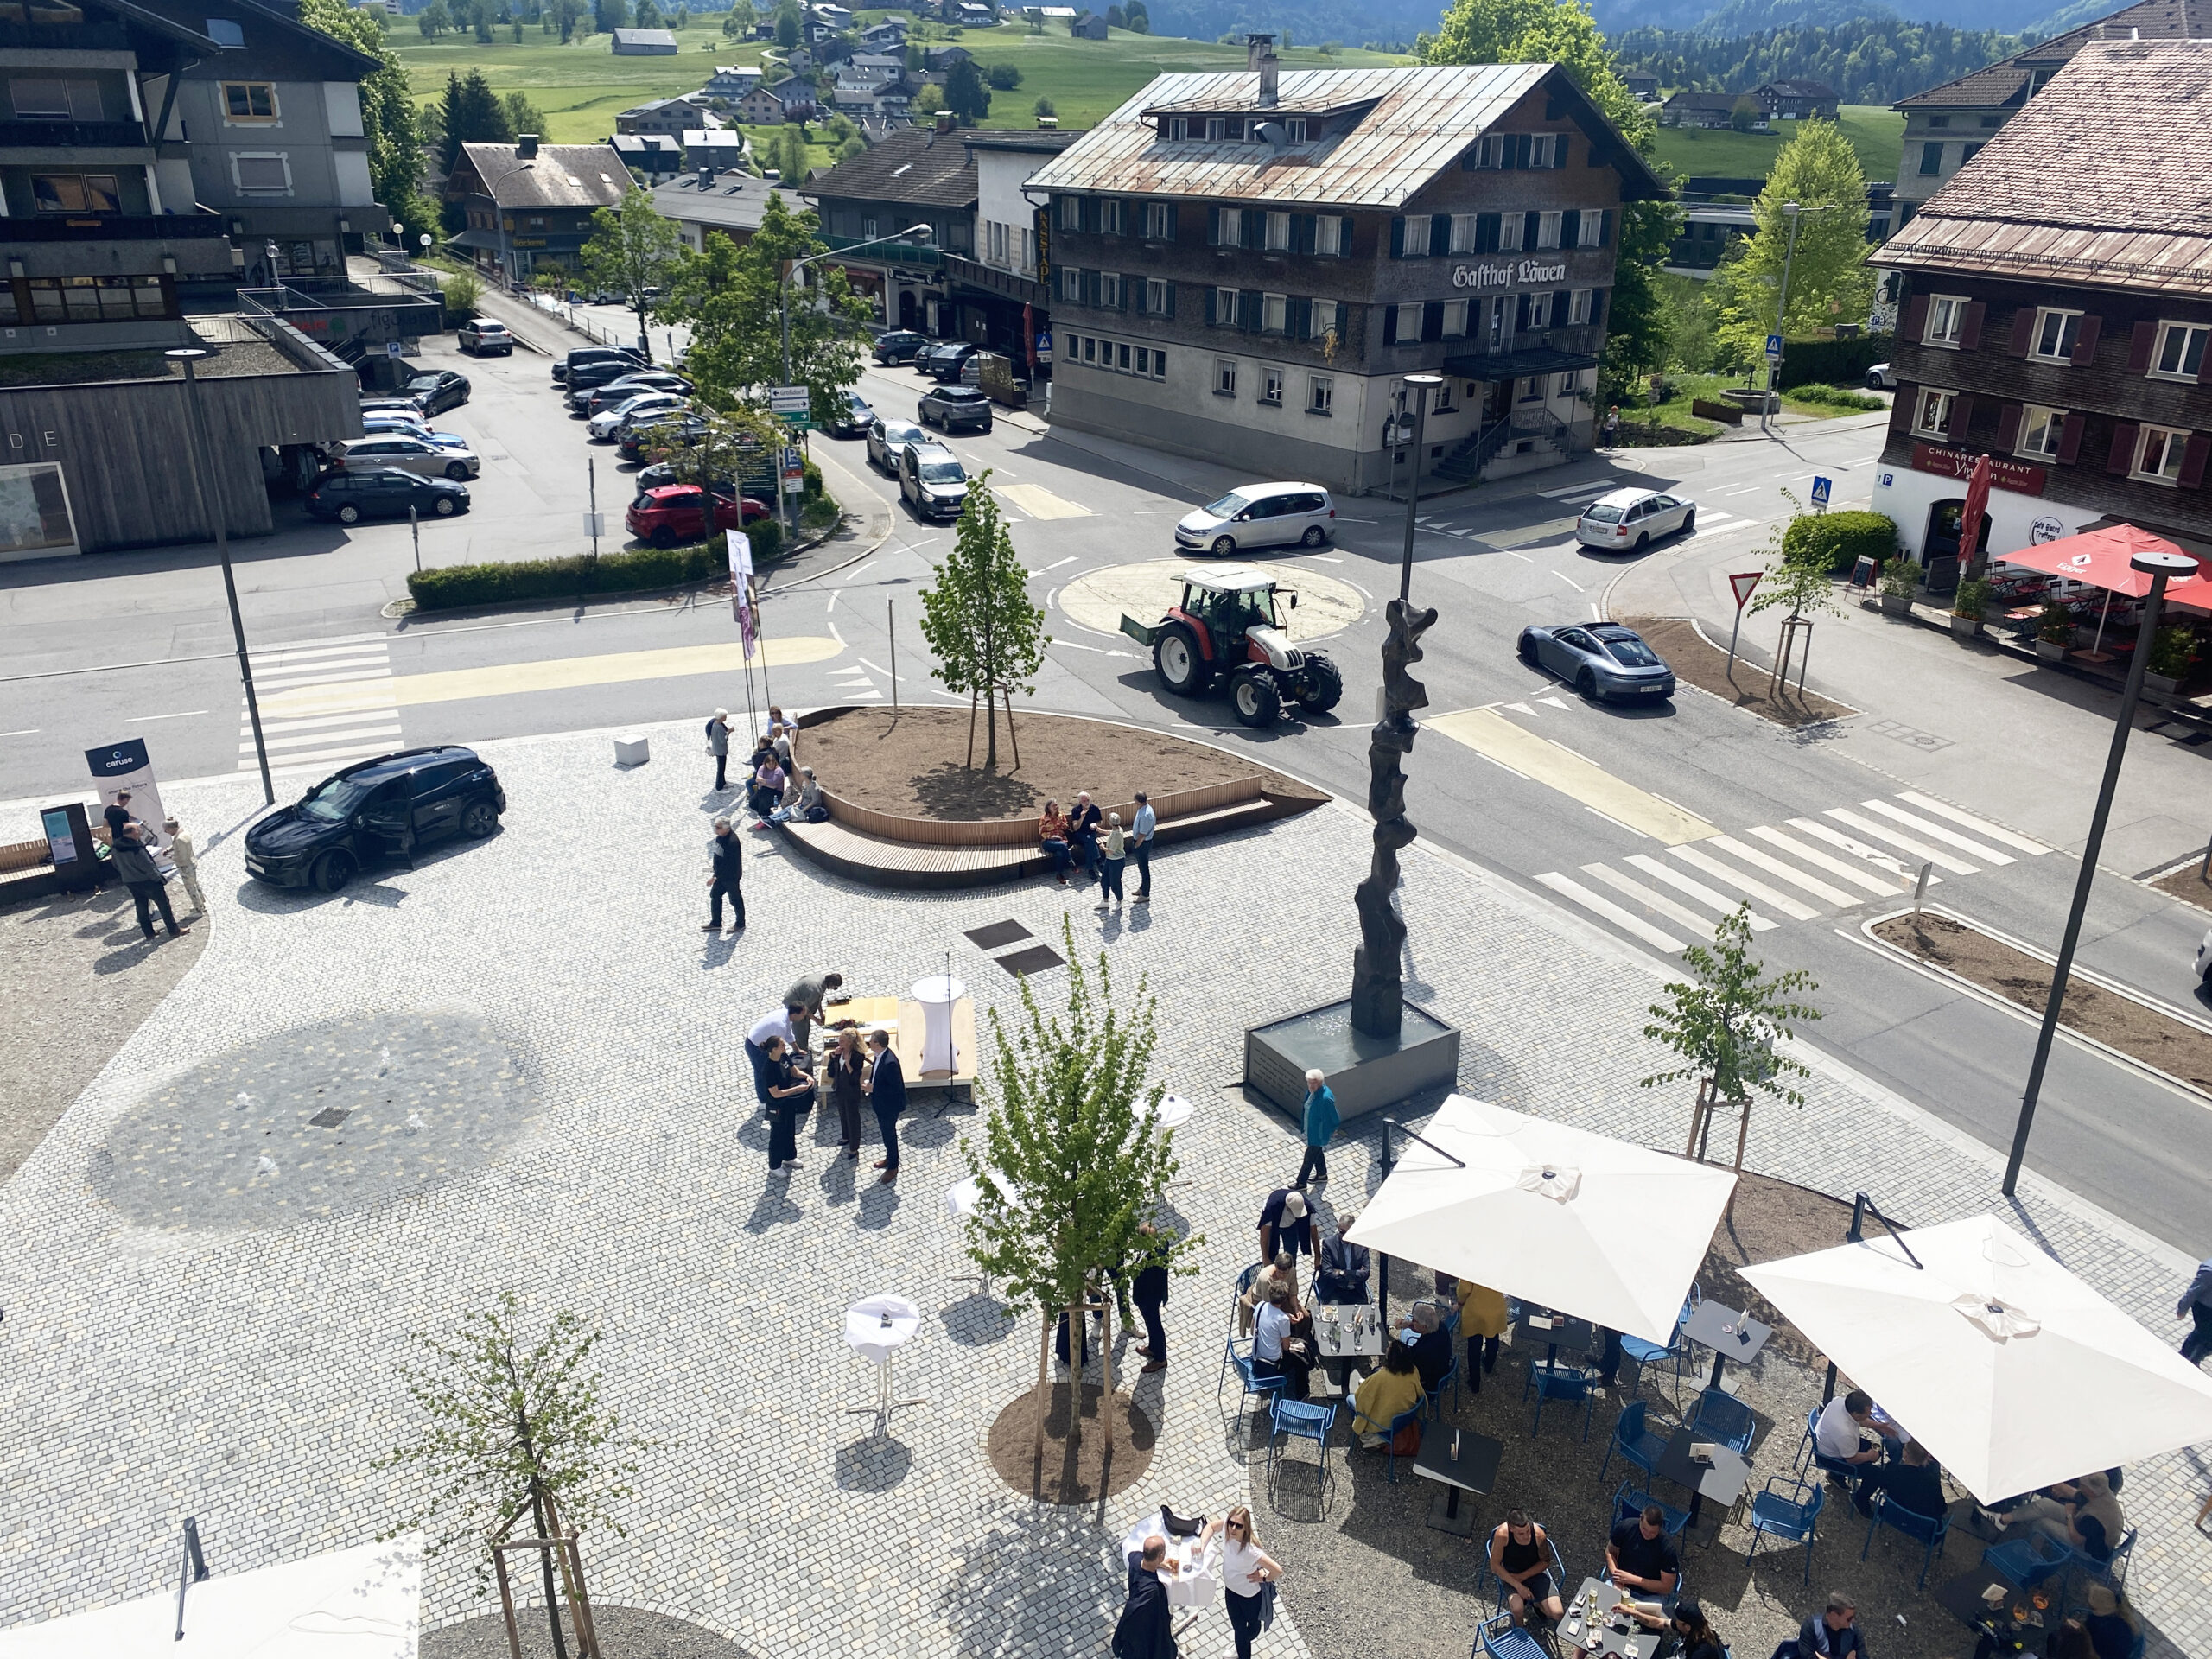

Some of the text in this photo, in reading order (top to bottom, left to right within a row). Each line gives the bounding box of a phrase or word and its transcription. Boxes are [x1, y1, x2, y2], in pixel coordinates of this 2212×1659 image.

[1517, 259, 1566, 283] Löwen
[1929, 448, 2031, 474] CHINARESAURANT
[2056, 562, 2088, 575] Egger
[105, 757, 133, 768] caruso
